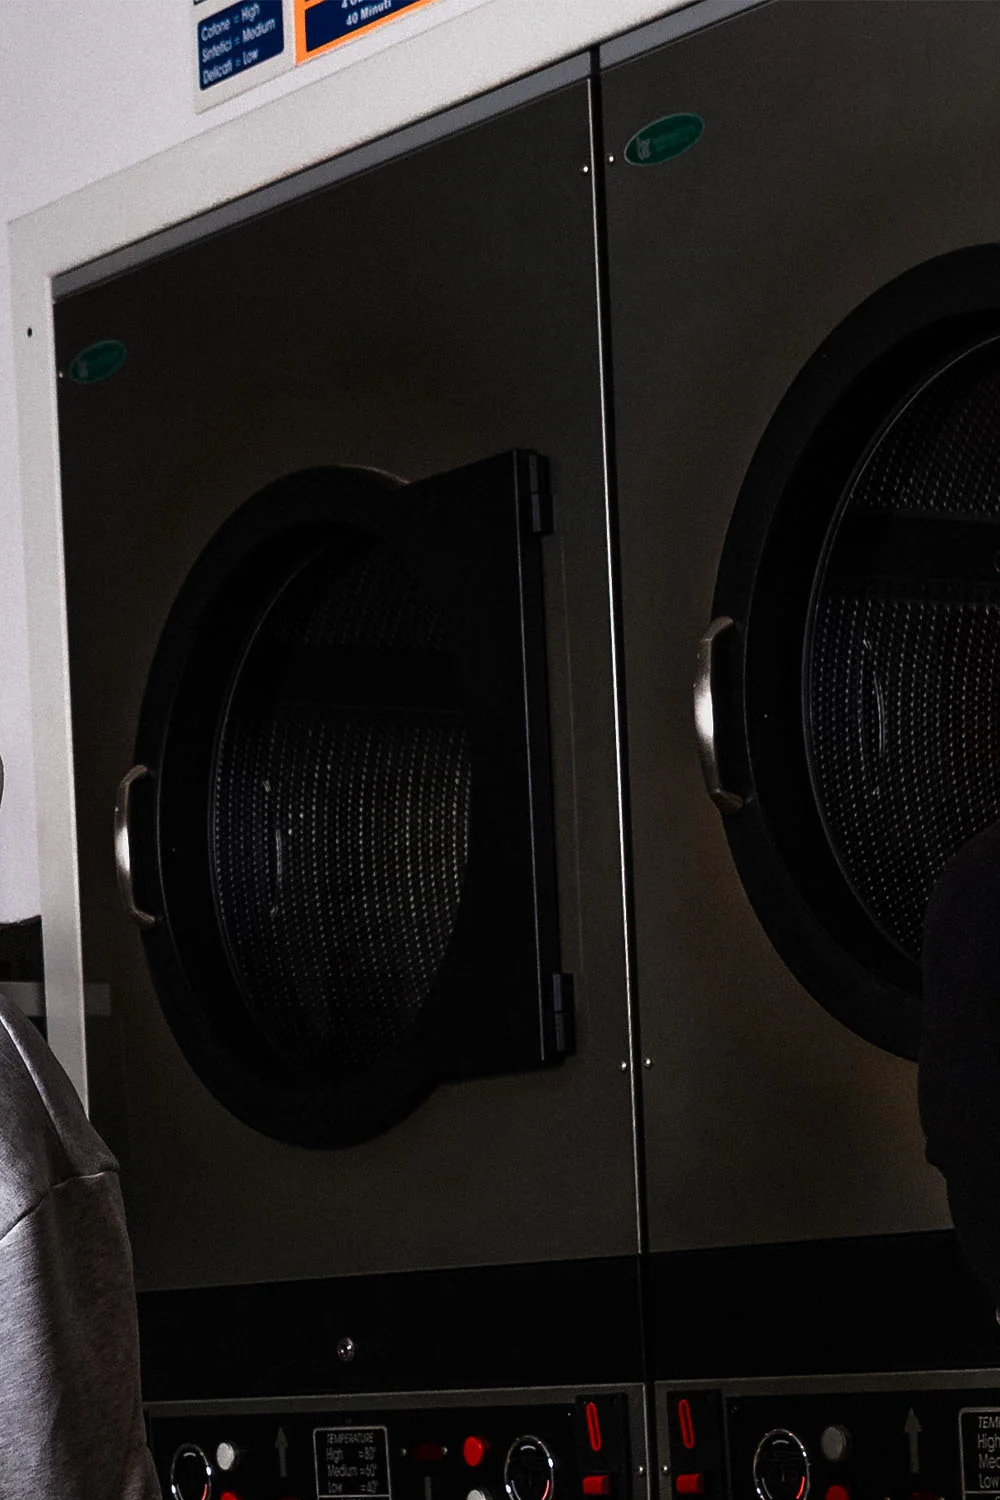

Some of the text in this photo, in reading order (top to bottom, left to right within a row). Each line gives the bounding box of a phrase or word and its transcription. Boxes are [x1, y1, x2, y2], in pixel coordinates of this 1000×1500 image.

[346, 0, 392, 26] 40 Minuti
[201, 19, 230, 41] Cotone
[242, 18, 275, 43] Medium
[327, 1432, 375, 1445] TEMPERATURE
[326, 1446, 344, 1464] High
[327, 1463, 358, 1478] Medium
[328, 1480, 344, 1494] Low
[979, 1472, 1000, 1489] Low
